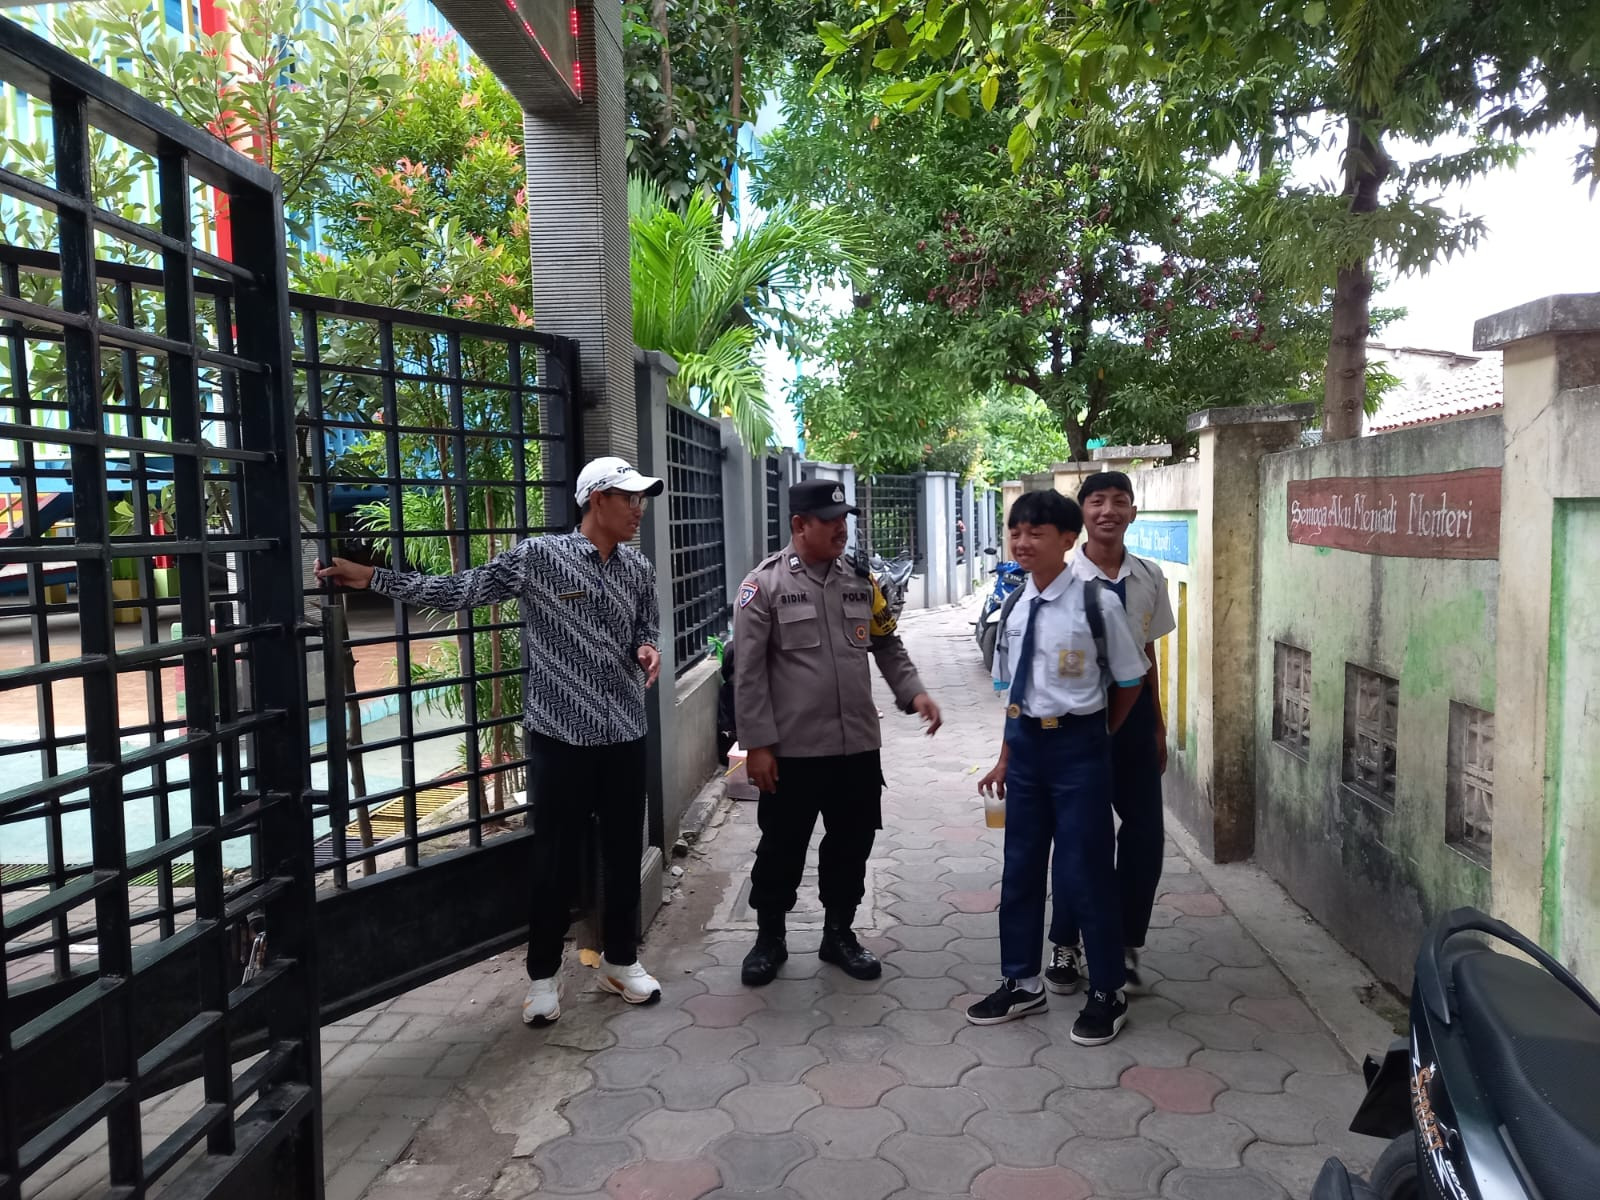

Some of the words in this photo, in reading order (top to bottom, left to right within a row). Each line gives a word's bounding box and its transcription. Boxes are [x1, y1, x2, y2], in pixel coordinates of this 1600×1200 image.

[1291, 500, 1328, 538] Semoga
[1328, 494, 1351, 529] Aku
[1352, 493, 1398, 545] Menjadi
[1406, 491, 1473, 539] Menteri
[842, 592, 868, 602] POLRI
